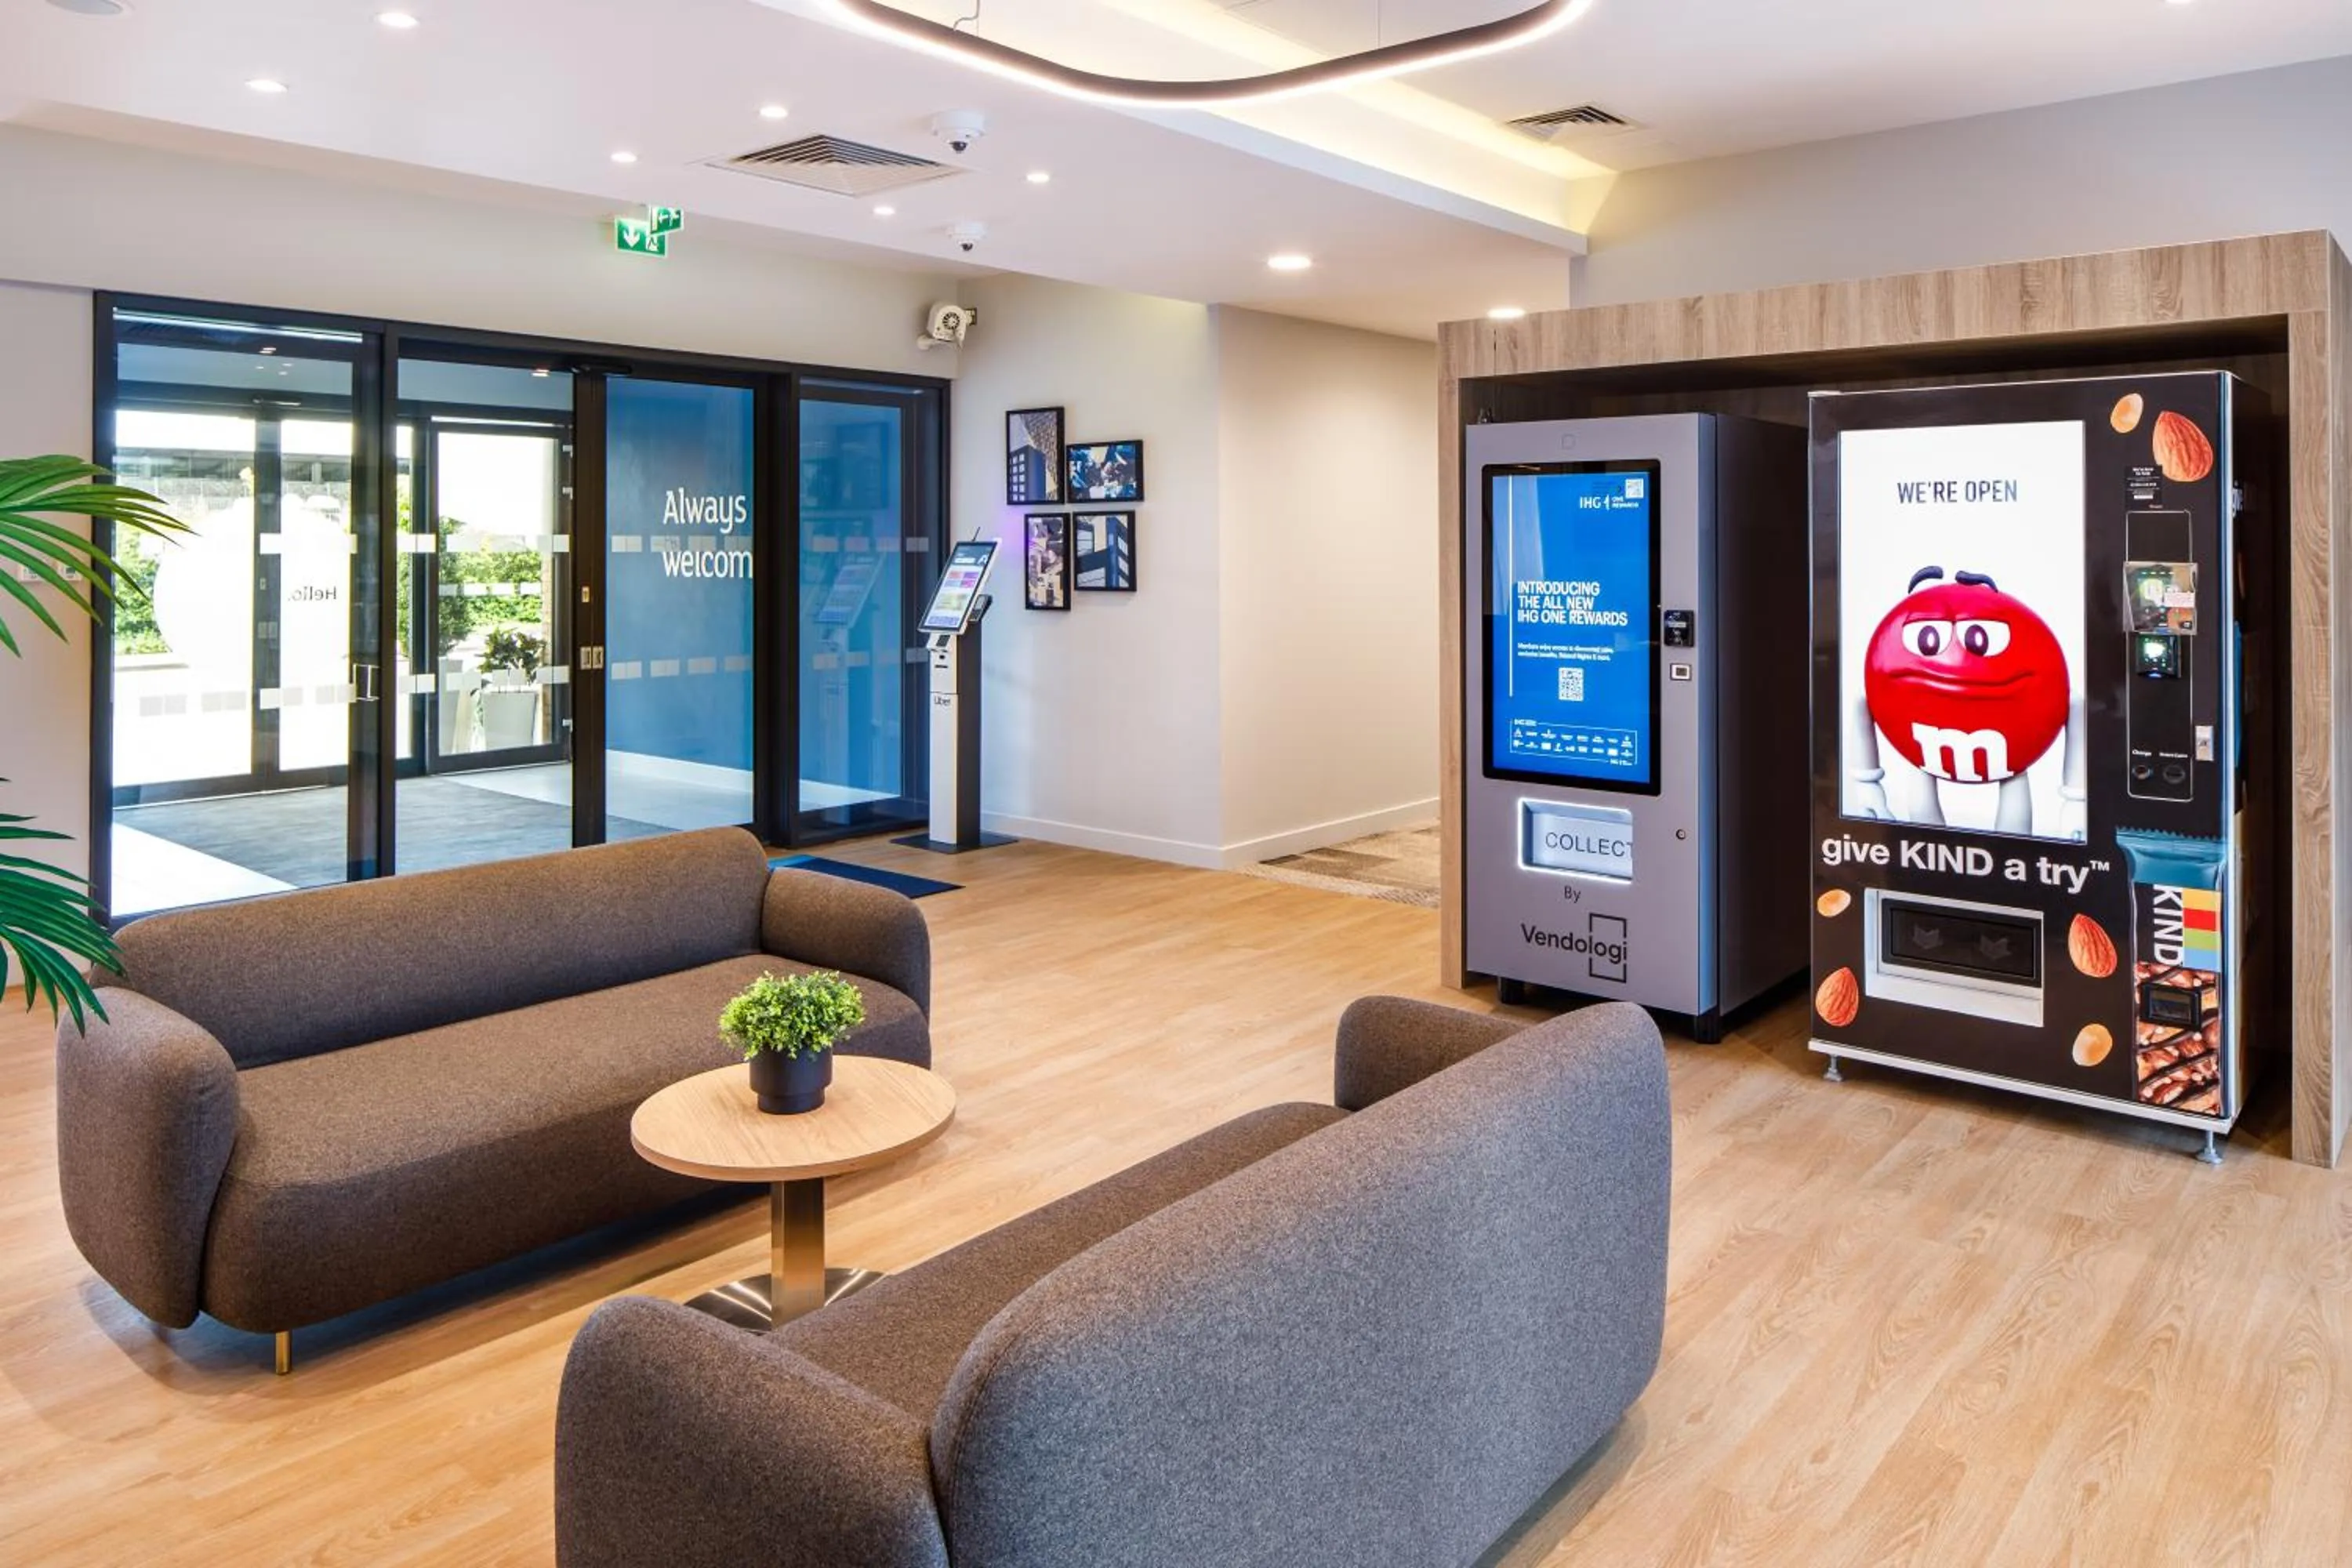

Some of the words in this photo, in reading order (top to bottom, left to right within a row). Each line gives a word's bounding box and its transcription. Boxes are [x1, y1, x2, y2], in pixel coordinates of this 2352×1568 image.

[1580, 496, 1601, 509] IHG
[1897, 481, 1958, 504] WE'RE
[1965, 480, 2018, 503] OPEN
[662, 487, 747, 534] Always
[1517, 580, 1600, 597] INTRODUCING
[1518, 595, 1541, 609] THE
[1542, 596, 1564, 610] ALL
[1566, 597, 1595, 611] NEW
[1517, 610, 1539, 623] IHG
[1541, 610, 1567, 625] ONE
[1569, 611, 1628, 626] REWARDS
[1911, 721, 2014, 782] m
[1821, 833, 1890, 866] give
[1900, 840, 1994, 877] KIND
[2004, 858, 2027, 882] a
[1563, 885, 1581, 903] By
[2153, 884, 2183, 967] KIND
[1520, 923, 1628, 965] Vendologi
